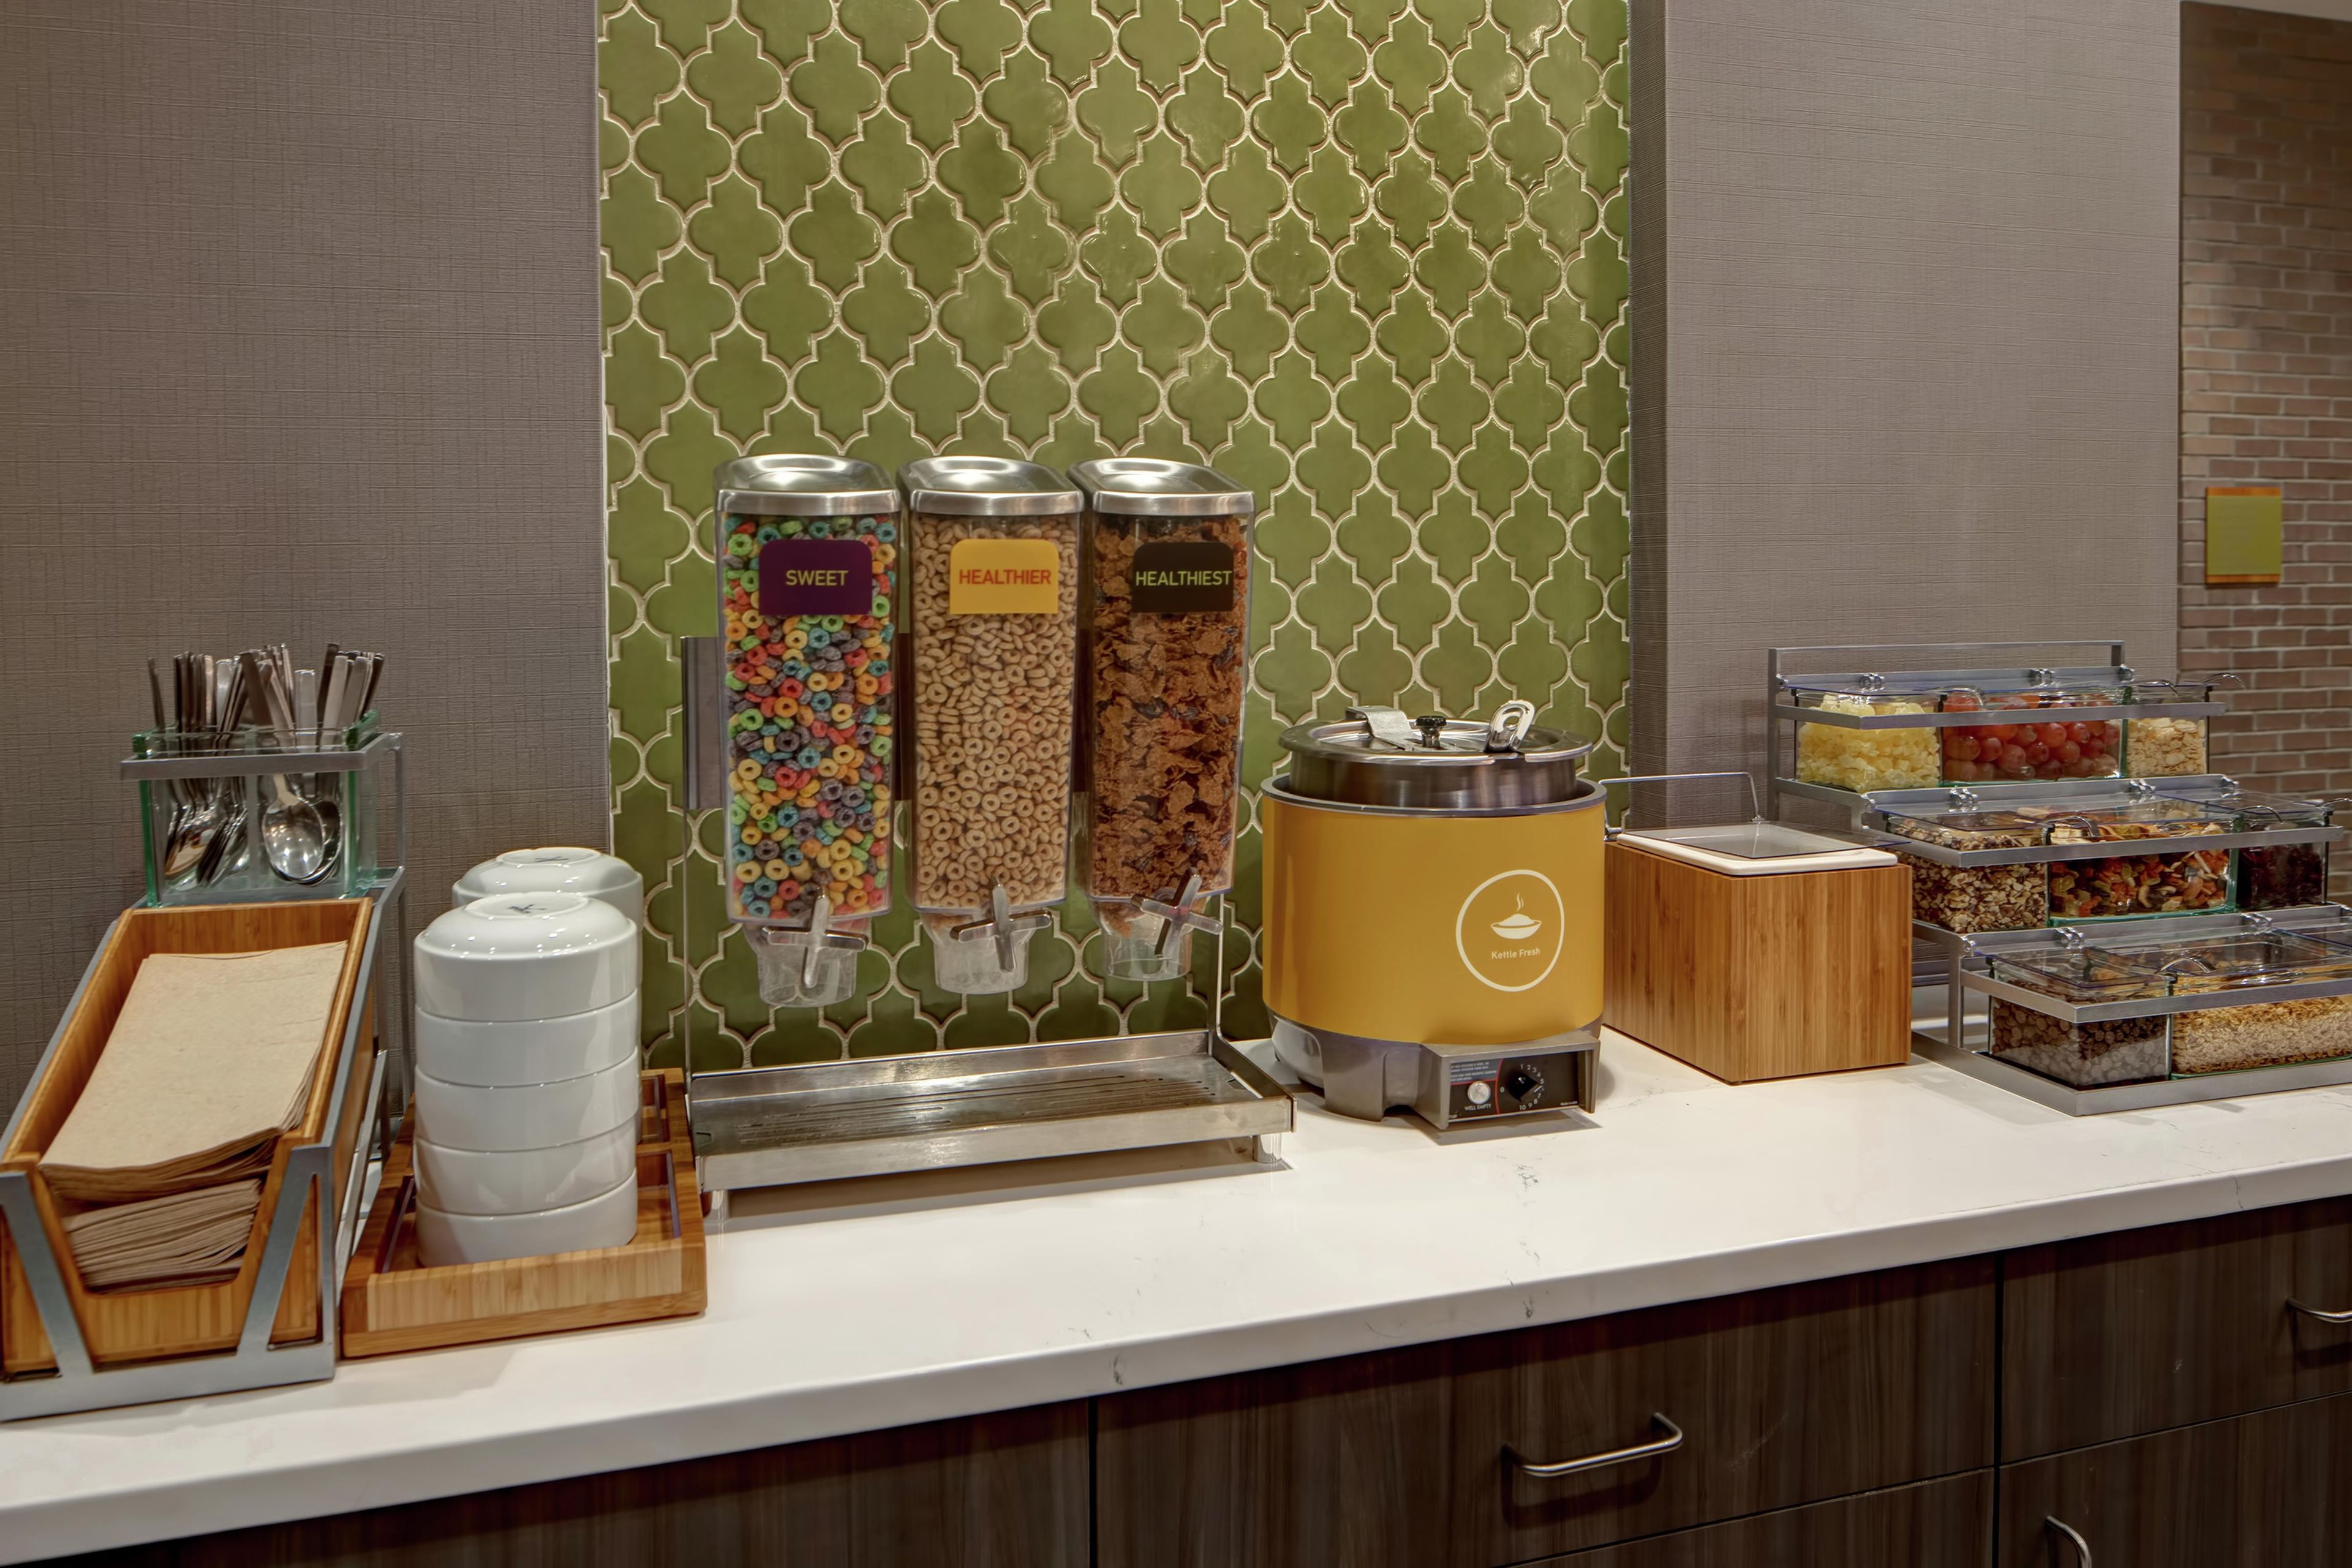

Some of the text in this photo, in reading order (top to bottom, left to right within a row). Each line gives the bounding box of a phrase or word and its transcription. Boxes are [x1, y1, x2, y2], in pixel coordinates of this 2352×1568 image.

[786, 570, 849, 586] SWEET
[959, 569, 1052, 585] HEALTHIER
[1136, 570, 1233, 586] HEALTHIEST
[1491, 947, 1540, 959] Kettle Fresh
